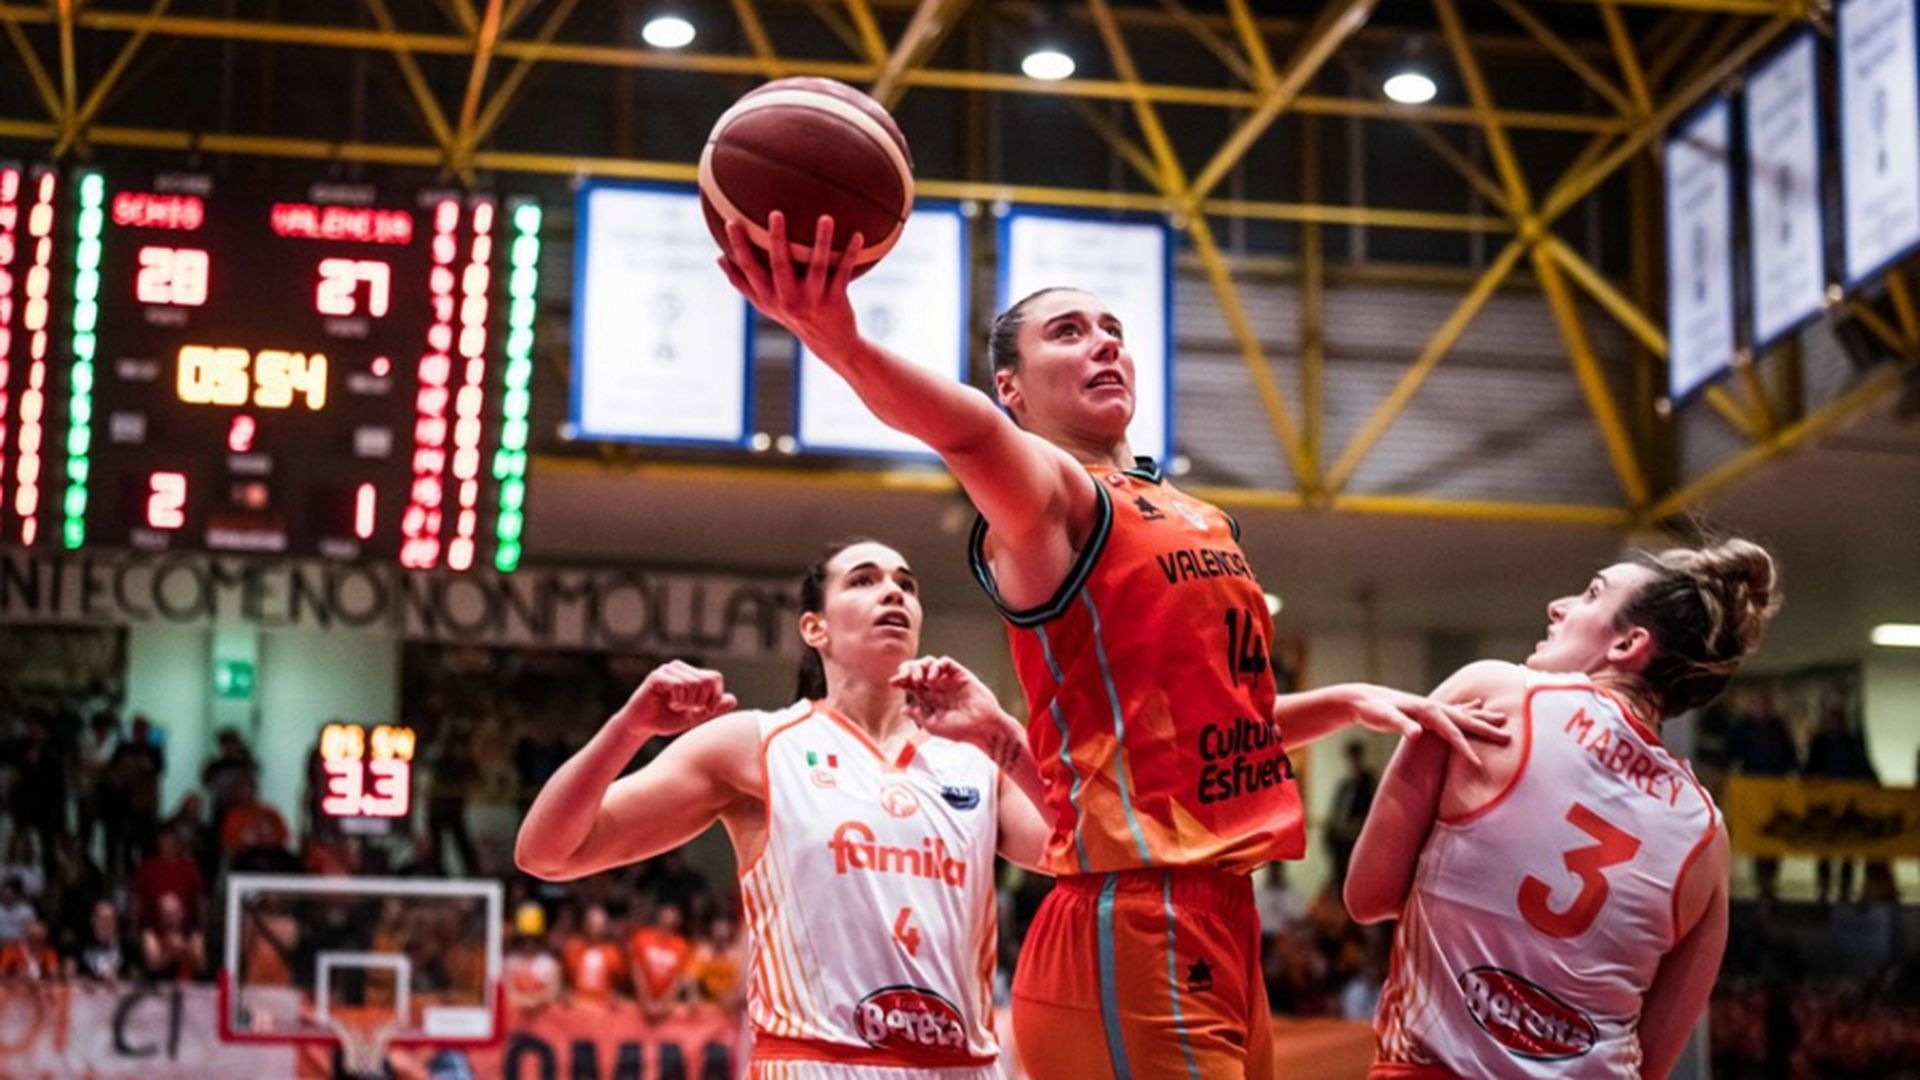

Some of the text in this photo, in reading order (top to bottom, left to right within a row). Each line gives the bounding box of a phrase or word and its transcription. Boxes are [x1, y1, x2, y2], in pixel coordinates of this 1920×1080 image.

[136, 246, 209, 306] 28
[316, 257, 391, 318] 27
[148, 472, 187, 528] 2
[355, 483, 376, 538] 1
[1224, 607, 1267, 690] 14
[1199, 716, 1283, 762] Cultur
[1563, 706, 1684, 807] MABREY
[828, 820, 967, 888] famila
[1516, 802, 1643, 939] 3
[892, 906, 921, 957] 4
